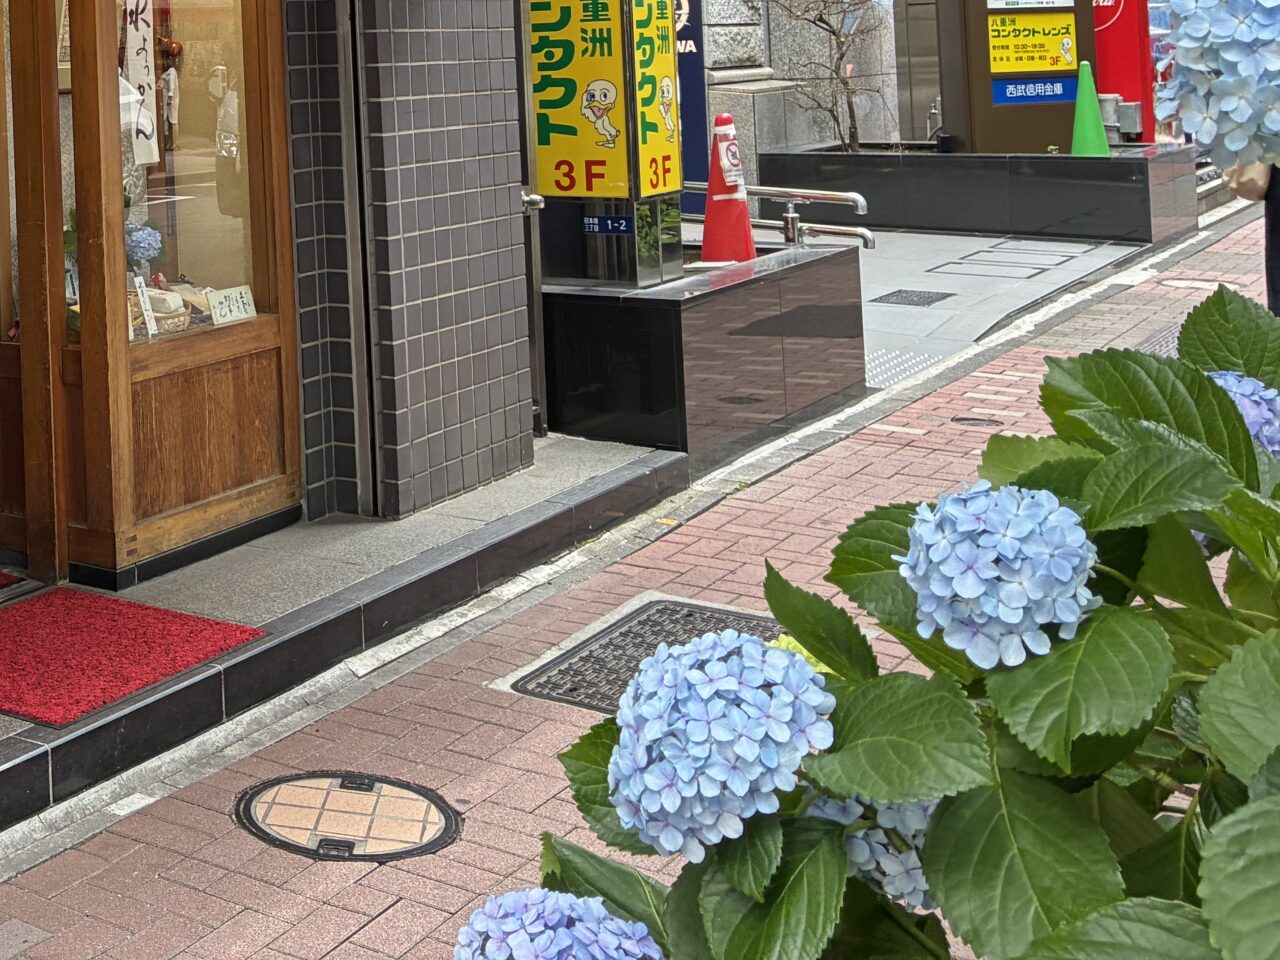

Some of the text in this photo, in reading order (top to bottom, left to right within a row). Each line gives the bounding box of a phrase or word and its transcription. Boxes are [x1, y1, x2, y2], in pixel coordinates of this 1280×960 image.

[991, 17, 1017, 27] 八重洲
[991, 24, 1072, 39] コンタクトレンズ
[1049, 56, 1062, 66] 3F
[1005, 82, 1064, 97] 西武信用金庫
[554, 159, 607, 192] 3F
[649, 154, 672, 190] 3F
[606, 219, 627, 230] 1-2
